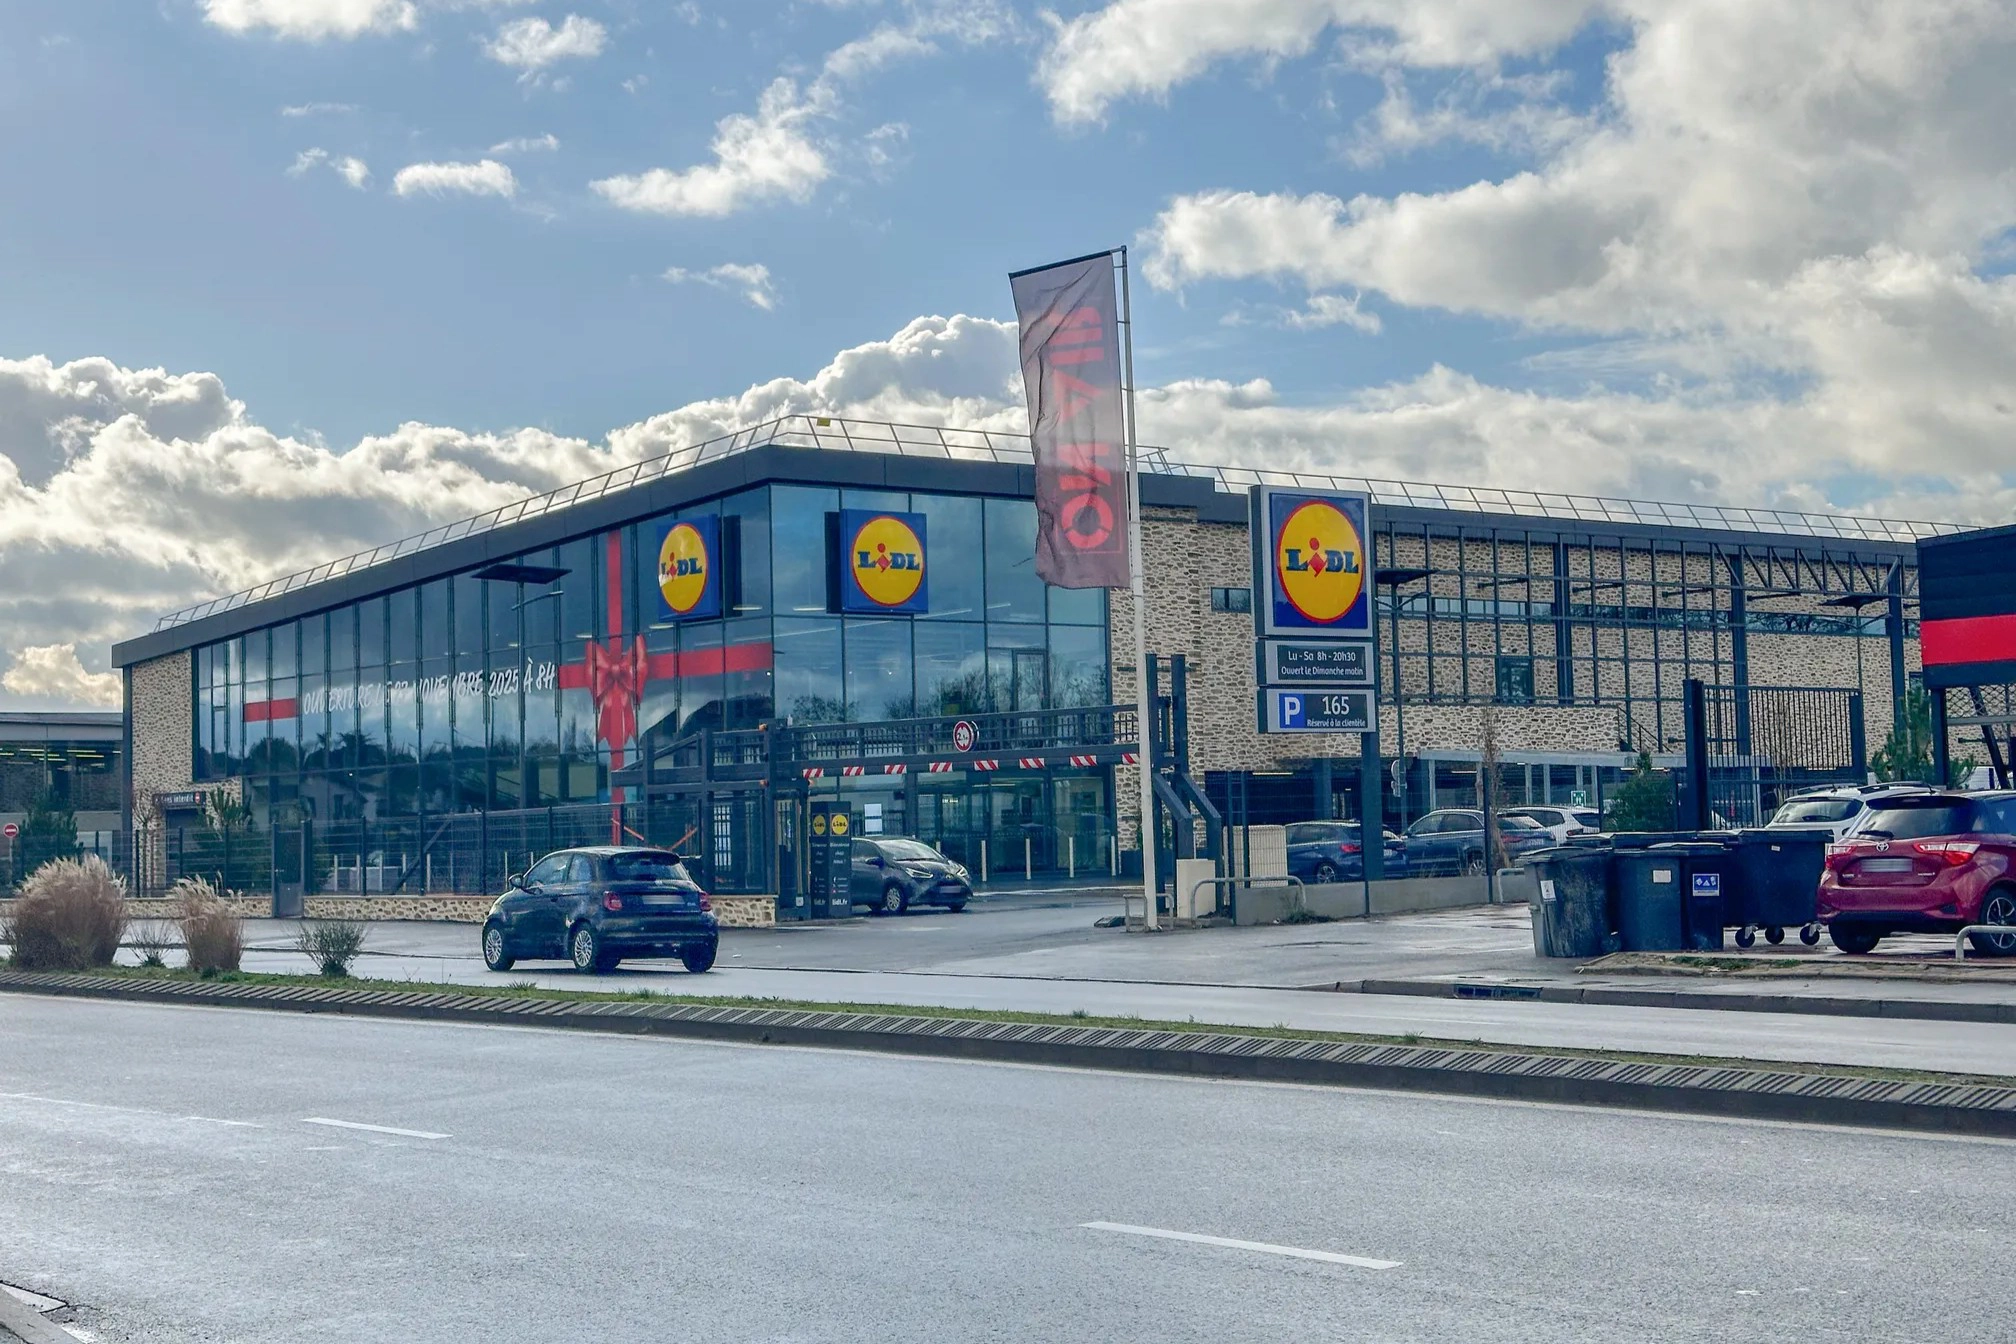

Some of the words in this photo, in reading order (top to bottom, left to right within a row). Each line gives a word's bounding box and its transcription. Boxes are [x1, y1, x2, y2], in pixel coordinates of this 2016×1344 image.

[1288, 651, 1297, 661] Lu
[1304, 651, 1314, 661] Sa
[1317, 651, 1327, 661] 8h
[1333, 651, 1356, 662] 20h30
[1281, 666, 1304, 675] Ouvert
[1305, 667, 1311, 675] le
[1312, 667, 1344, 676] Dimanche
[1345, 668, 1364, 676] matin
[303, 684, 373, 715] OUVERTURE
[488, 668, 518, 697] 2025
[523, 656, 533, 693] À
[536, 661, 555, 690] 8H
[1284, 697, 1301, 725] P
[1322, 695, 1350, 715] 165
[1307, 718, 1329, 727] Réservé
